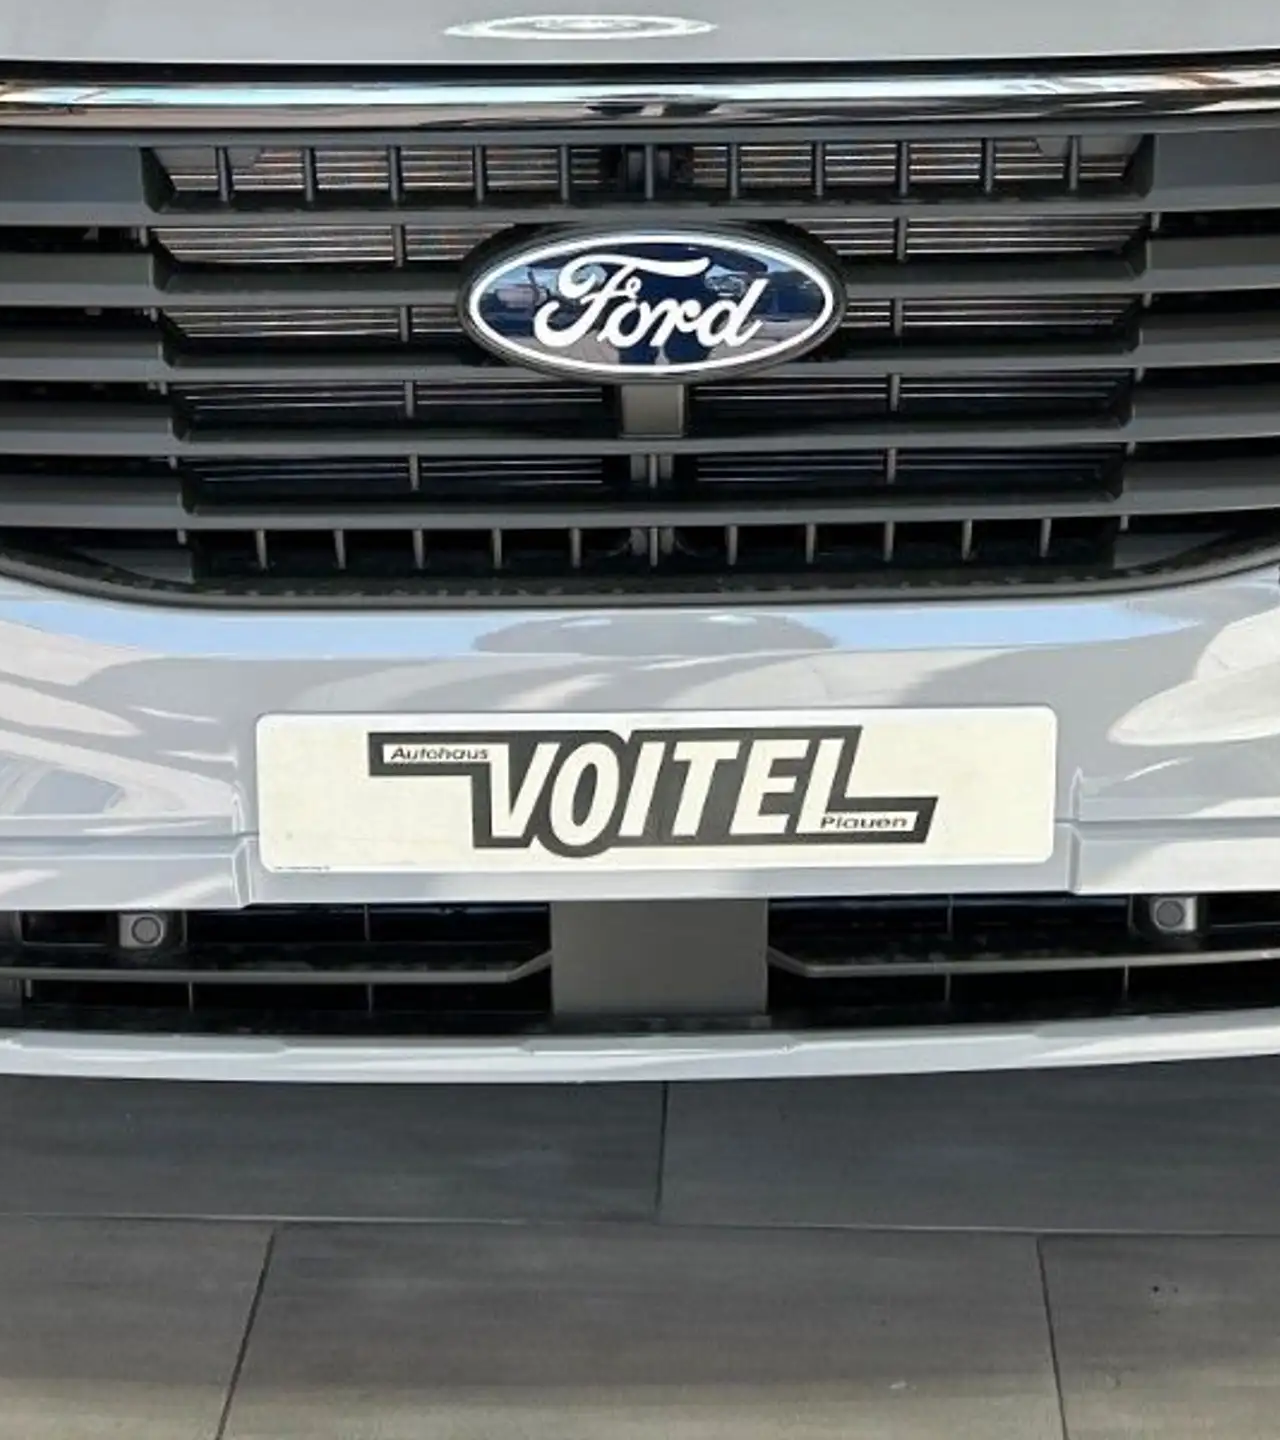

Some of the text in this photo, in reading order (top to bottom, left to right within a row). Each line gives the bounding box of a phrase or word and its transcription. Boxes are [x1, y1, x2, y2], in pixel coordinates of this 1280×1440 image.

[534, 252, 769, 348] Ford
[388, 744, 490, 763] Autohaus
[488, 736, 850, 848] VOITEL
[819, 813, 909, 832] Plauen
